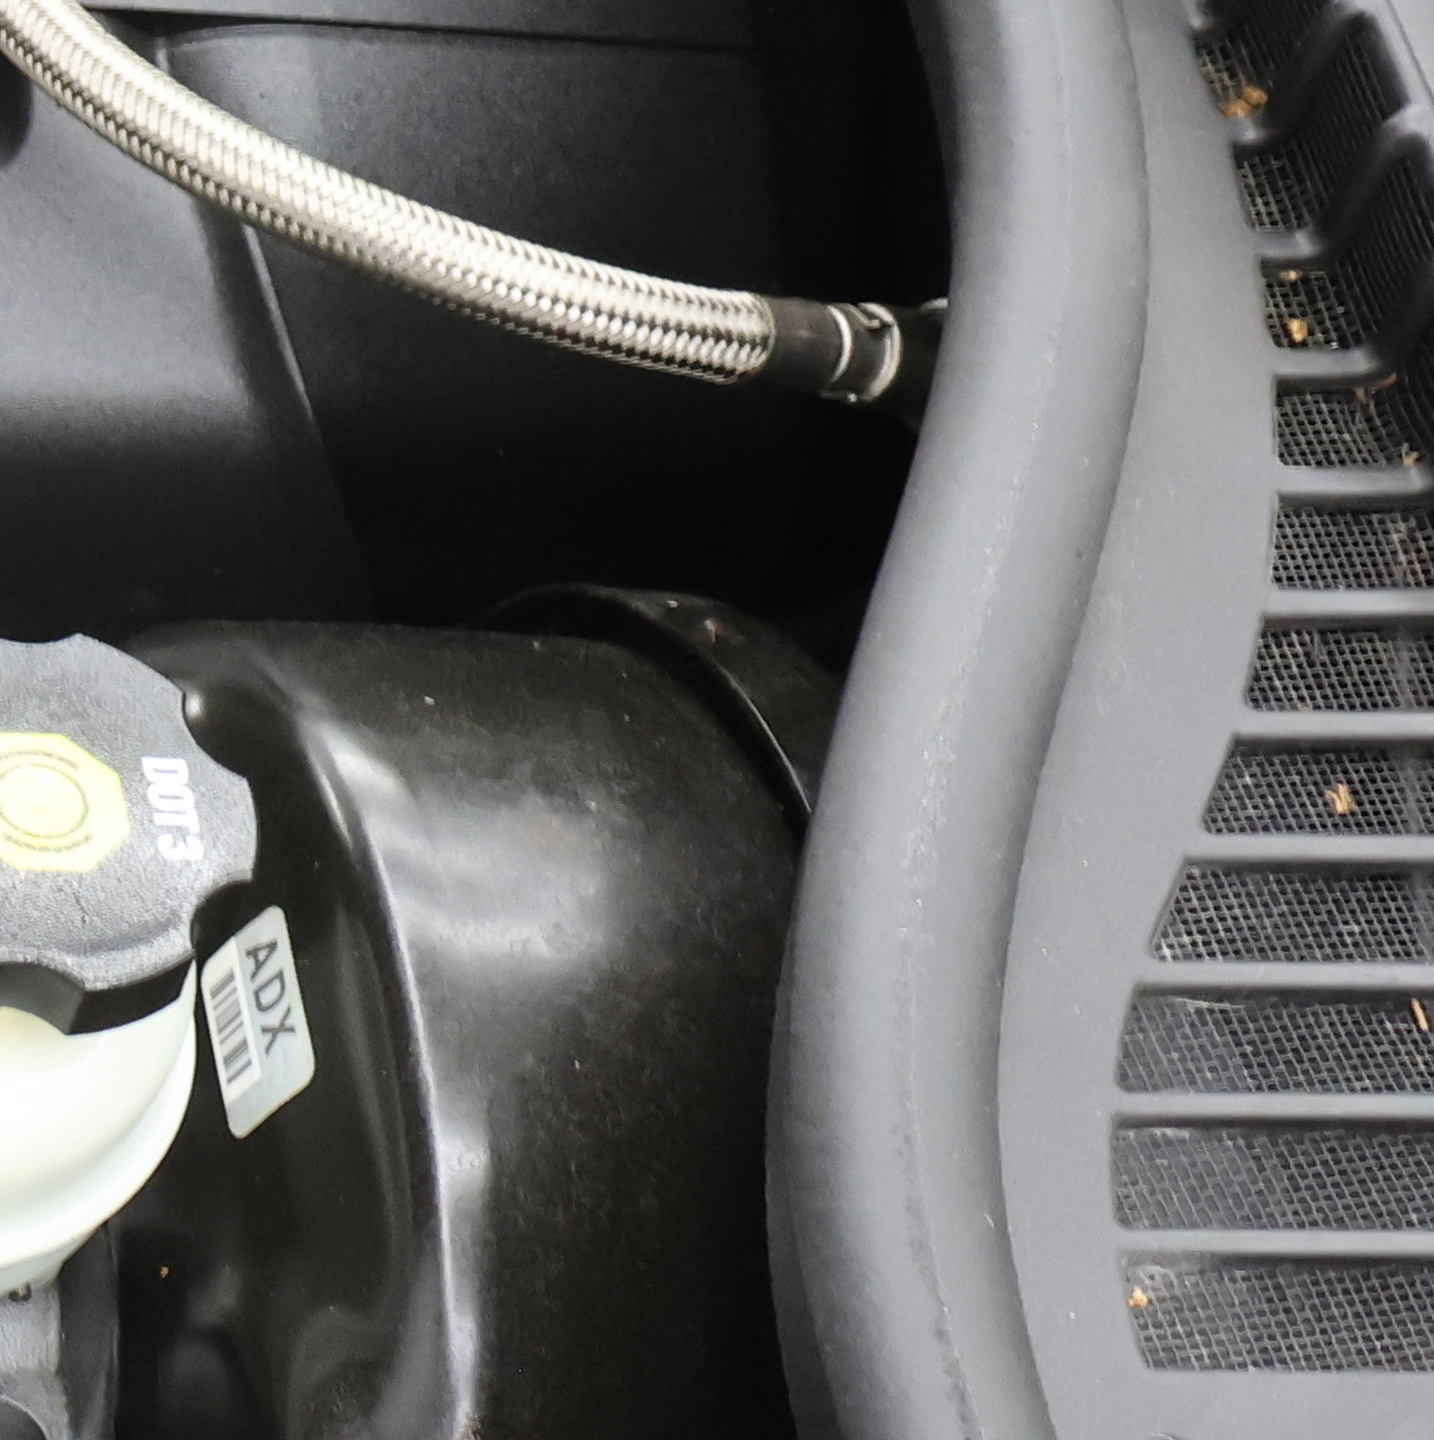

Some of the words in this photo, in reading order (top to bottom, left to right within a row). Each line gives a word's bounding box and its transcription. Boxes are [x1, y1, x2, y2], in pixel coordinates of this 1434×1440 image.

[140, 756, 200, 829] DOT
[157, 831, 205, 862] 3
[244, 936, 297, 1057] ADX
